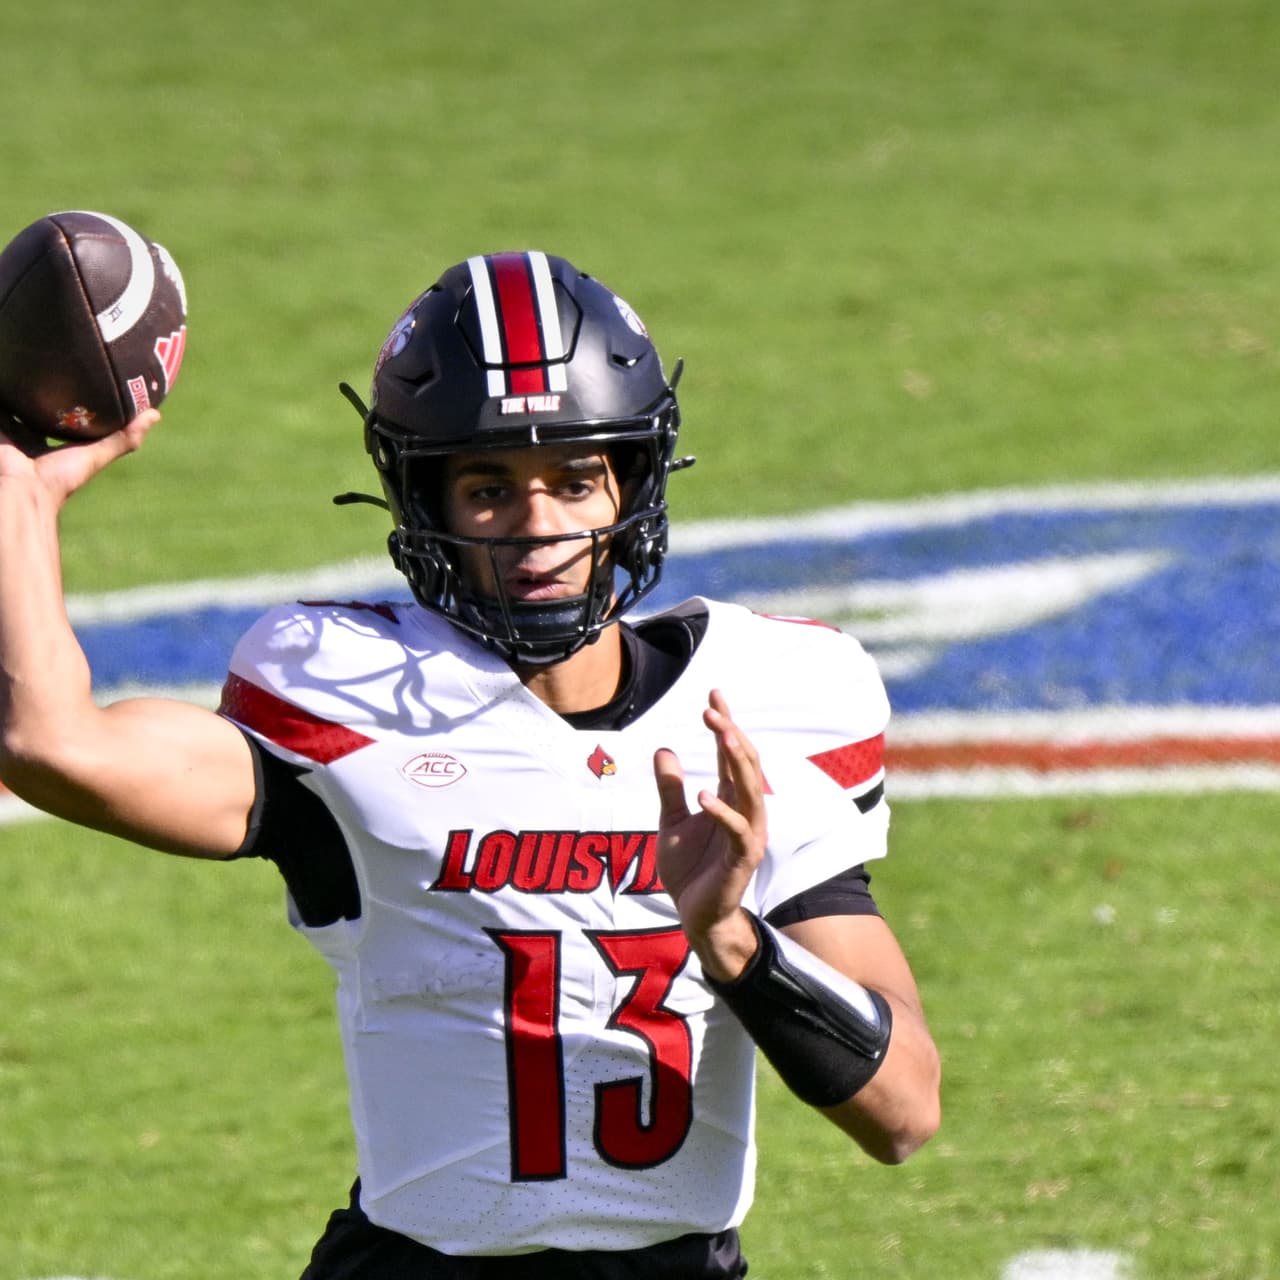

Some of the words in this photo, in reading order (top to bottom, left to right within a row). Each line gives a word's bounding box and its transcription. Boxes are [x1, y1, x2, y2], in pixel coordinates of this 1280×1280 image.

[412, 761, 458, 774] ACC
[426, 828, 668, 900] LOUISVI
[482, 925, 694, 1183] 13
